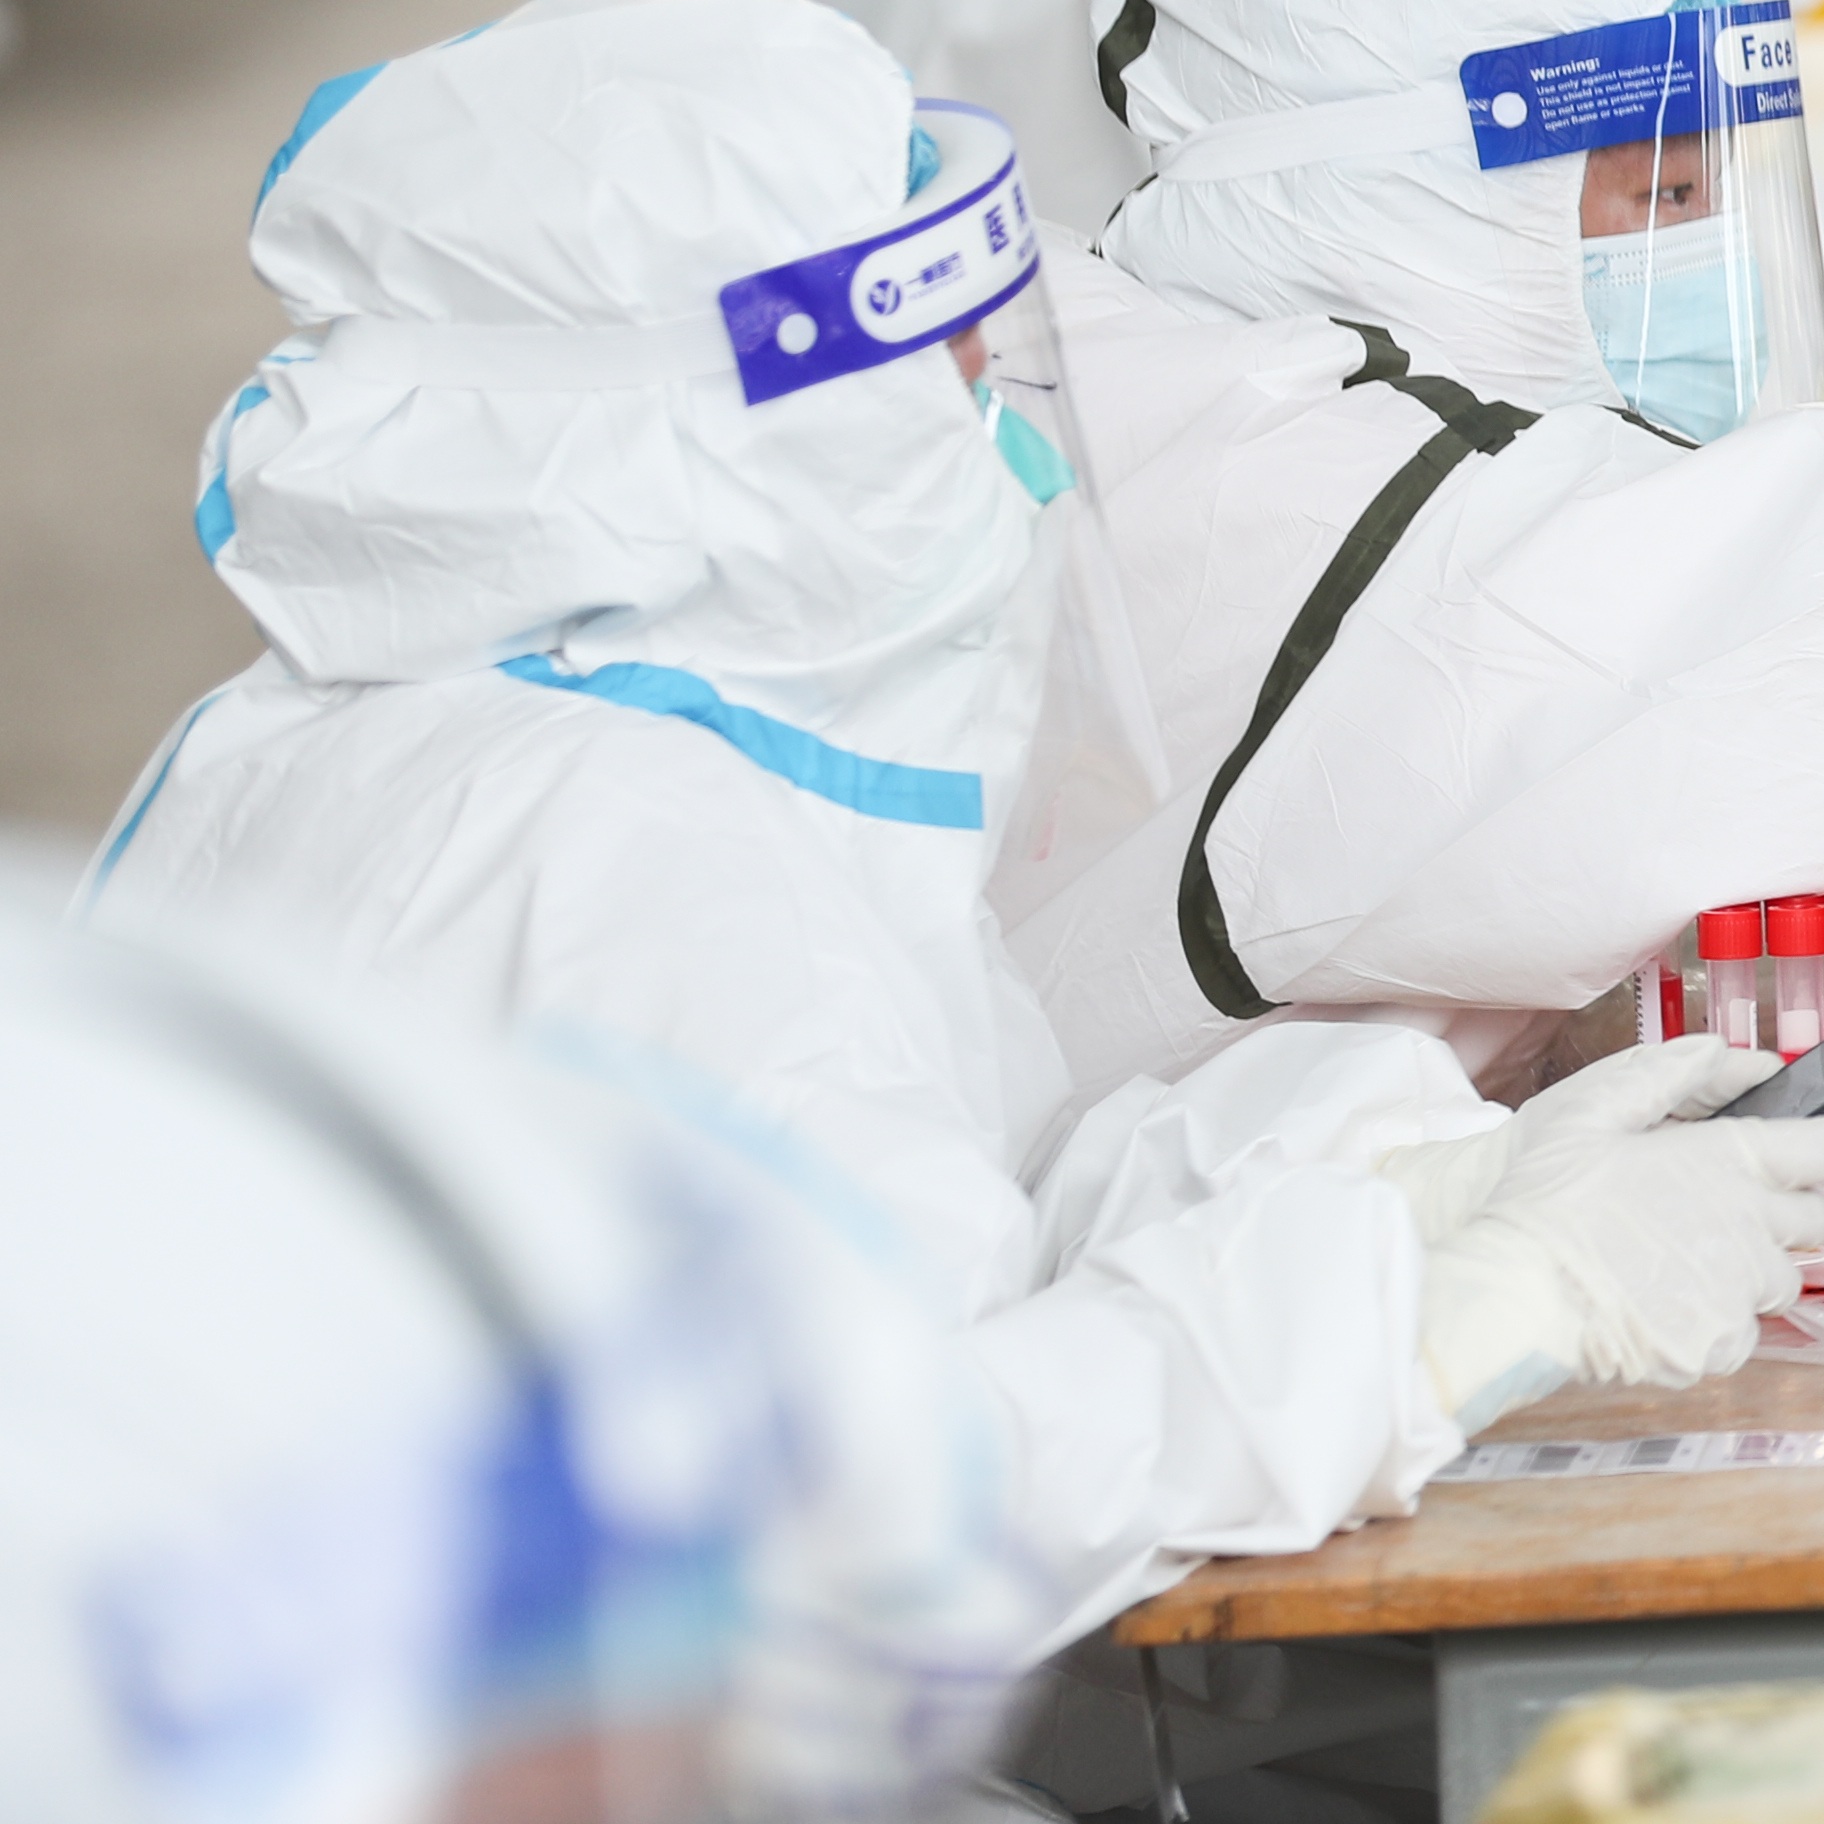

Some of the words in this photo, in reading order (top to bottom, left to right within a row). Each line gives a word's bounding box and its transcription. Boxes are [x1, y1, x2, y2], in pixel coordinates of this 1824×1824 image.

[1741, 34, 1792, 71] Face
[1536, 85, 1556, 96] Use
[1557, 79, 1579, 92] only
[1581, 70, 1617, 87] against
[1617, 64, 1651, 79] liquids
[1539, 96, 1561, 108] This
[1562, 87, 1593, 101] shield
[1605, 81, 1622, 94] not
[1622, 75, 1655, 90] impact
[1558, 104, 1575, 116] not
[1576, 100, 1595, 112] use
[1610, 89, 1658, 106] protection
[1756, 89, 1788, 114] Direct
[1544, 118, 1570, 132] open
[1612, 103, 1646, 118] sparks
